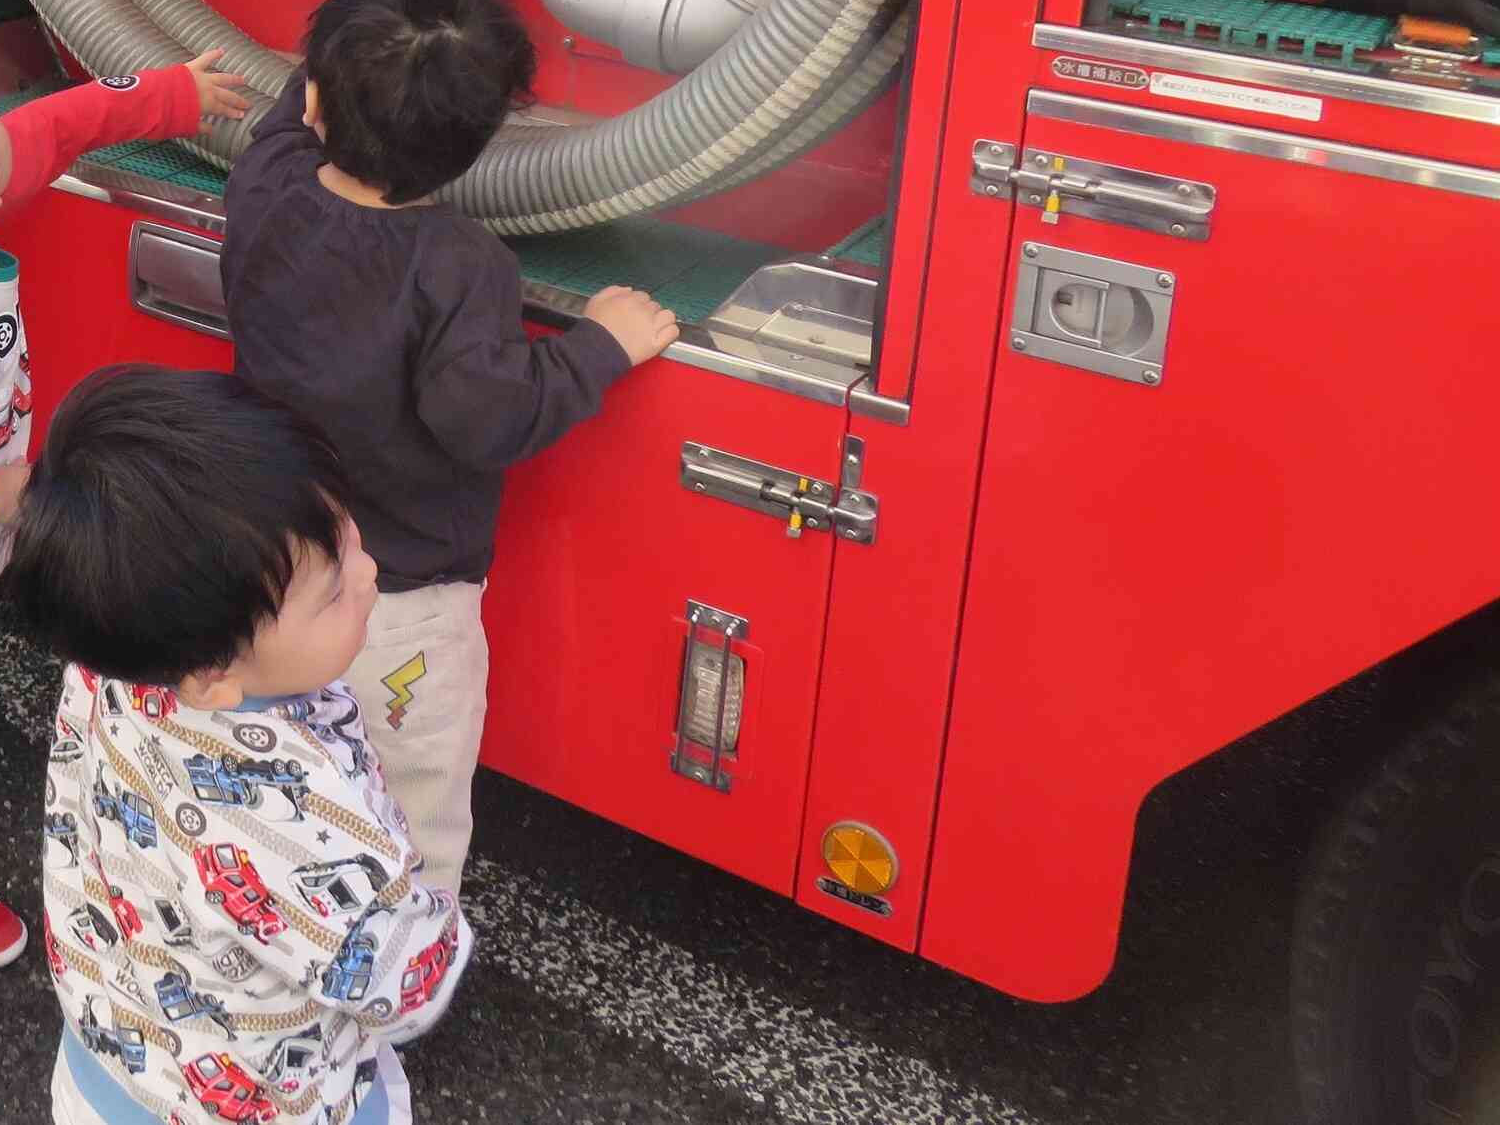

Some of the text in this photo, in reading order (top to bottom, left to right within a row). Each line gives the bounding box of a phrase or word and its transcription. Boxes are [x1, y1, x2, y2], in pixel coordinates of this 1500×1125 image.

[1059, 60, 1138, 87] 水槽補給口
